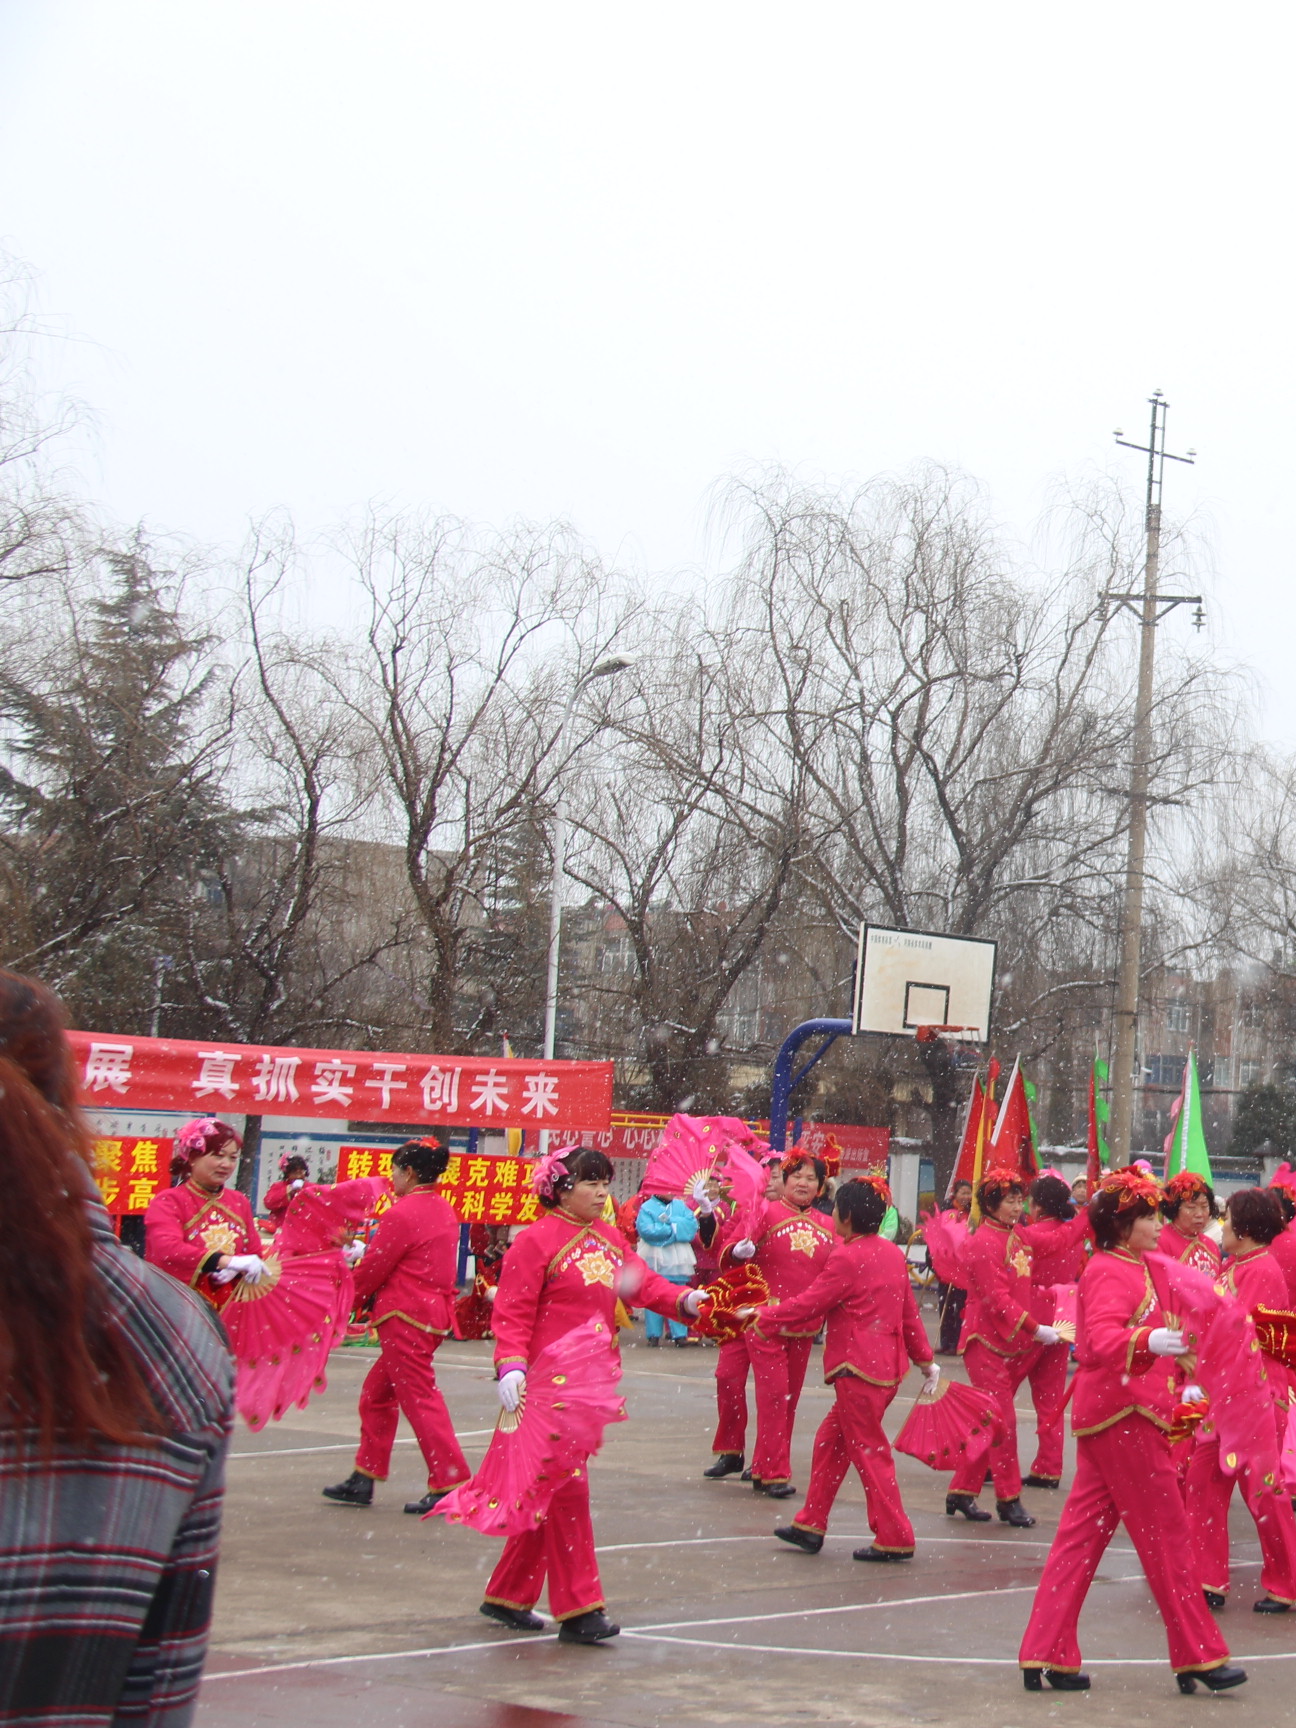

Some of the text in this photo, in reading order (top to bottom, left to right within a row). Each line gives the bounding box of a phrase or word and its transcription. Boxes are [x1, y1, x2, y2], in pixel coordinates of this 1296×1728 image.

[82, 1042, 560, 1117] 展 真抓实干创未来
